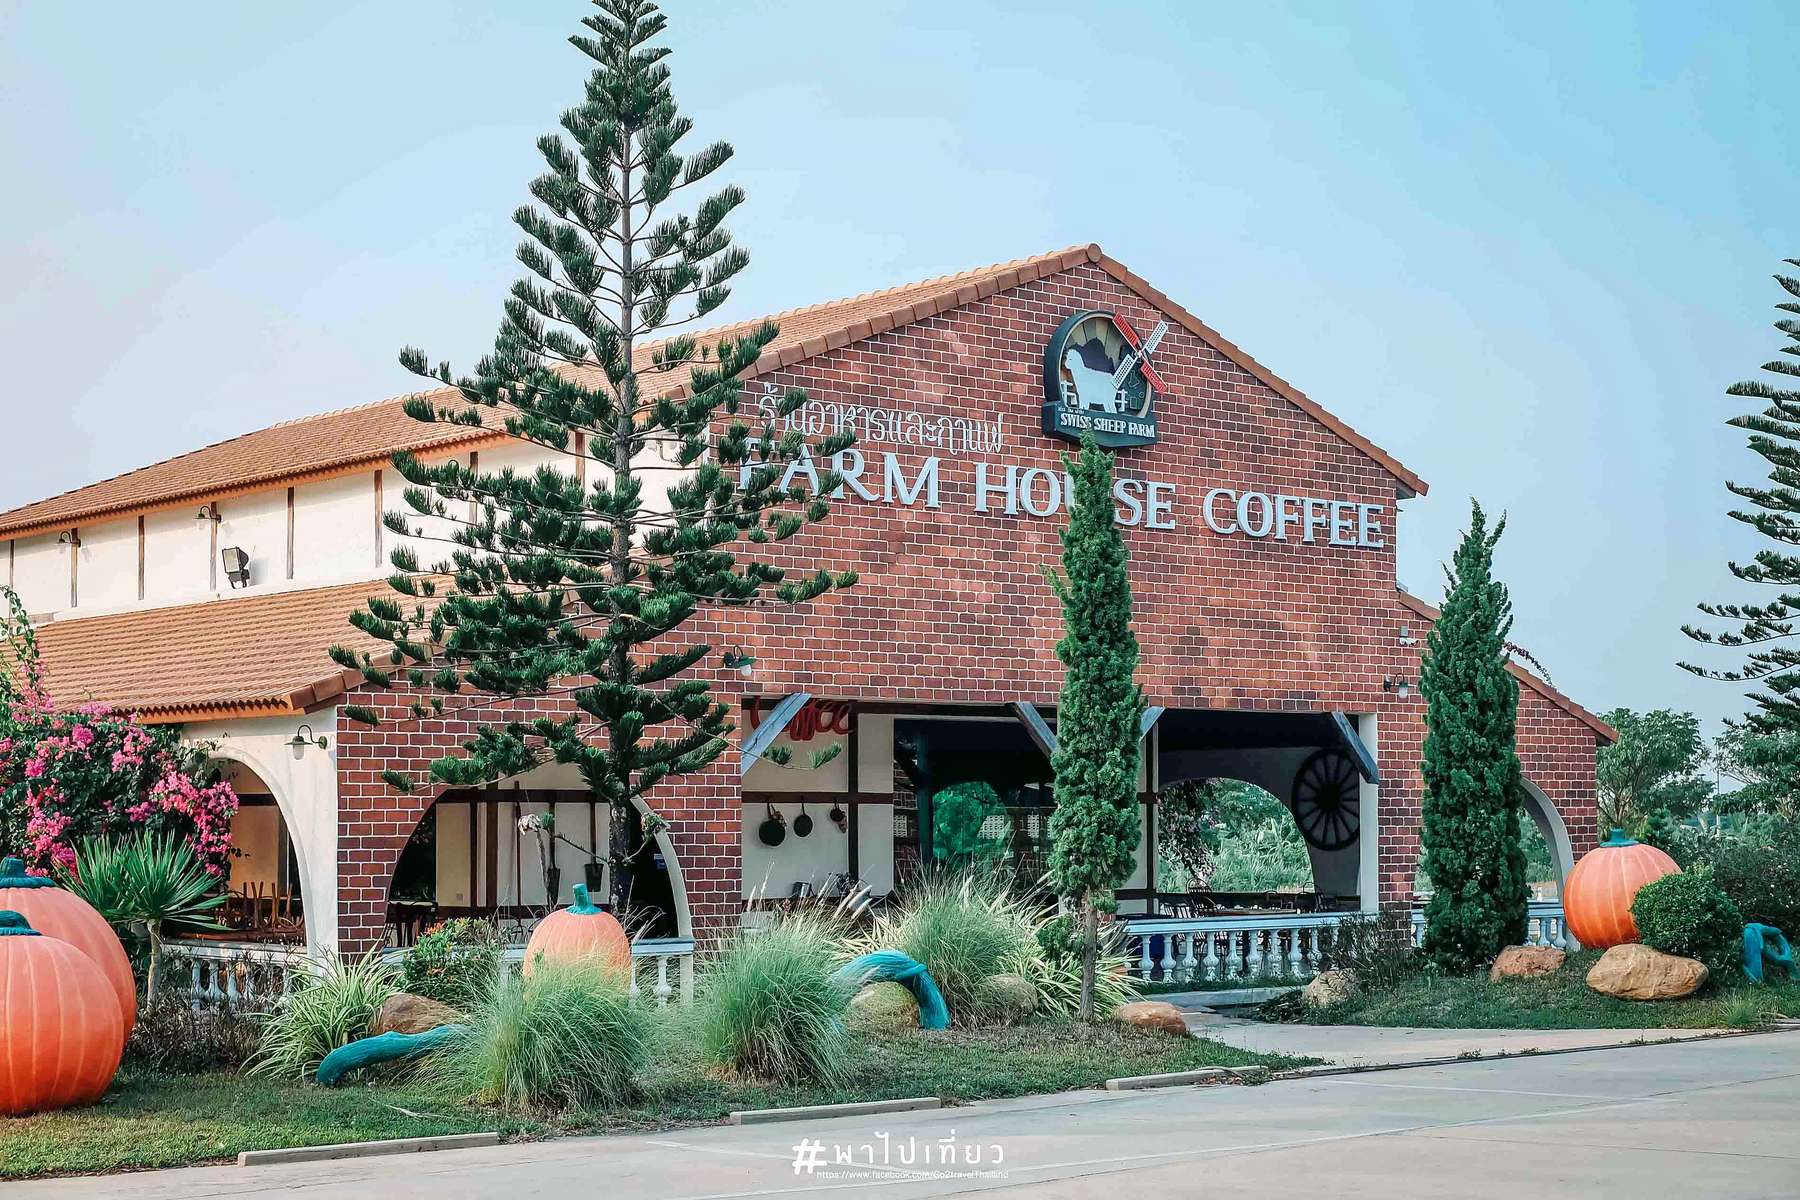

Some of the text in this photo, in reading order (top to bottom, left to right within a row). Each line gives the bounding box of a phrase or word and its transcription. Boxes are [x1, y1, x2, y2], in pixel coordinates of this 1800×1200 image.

[1060, 413, 1155, 437] SWISS SHEEP FARM
[1203, 488, 1384, 548] COFFEE
